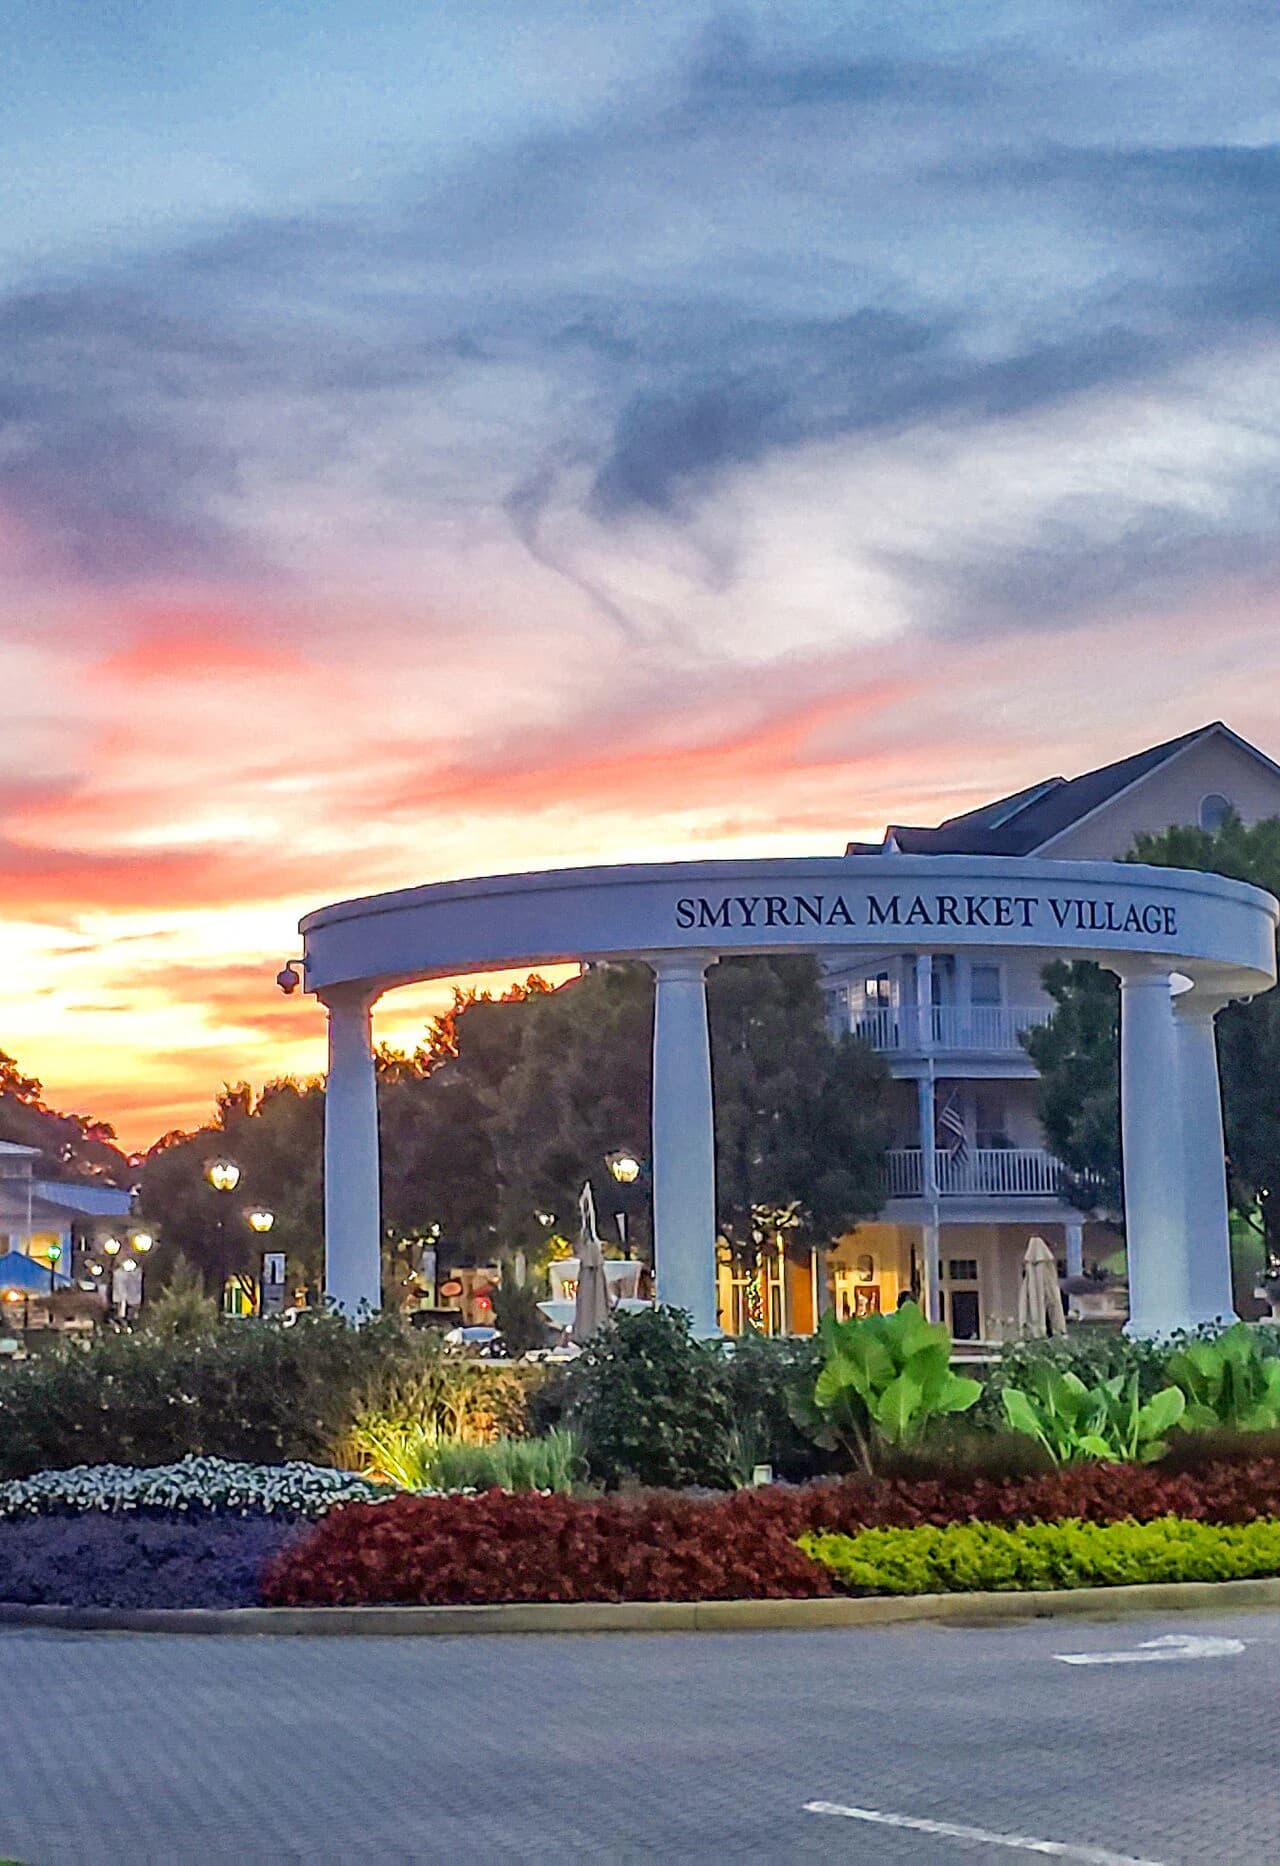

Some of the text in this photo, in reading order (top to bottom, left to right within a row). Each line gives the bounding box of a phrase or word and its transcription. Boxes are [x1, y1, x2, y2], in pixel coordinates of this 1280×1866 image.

[675, 895, 1178, 937] SMYRNA MARKET VILLAGE
